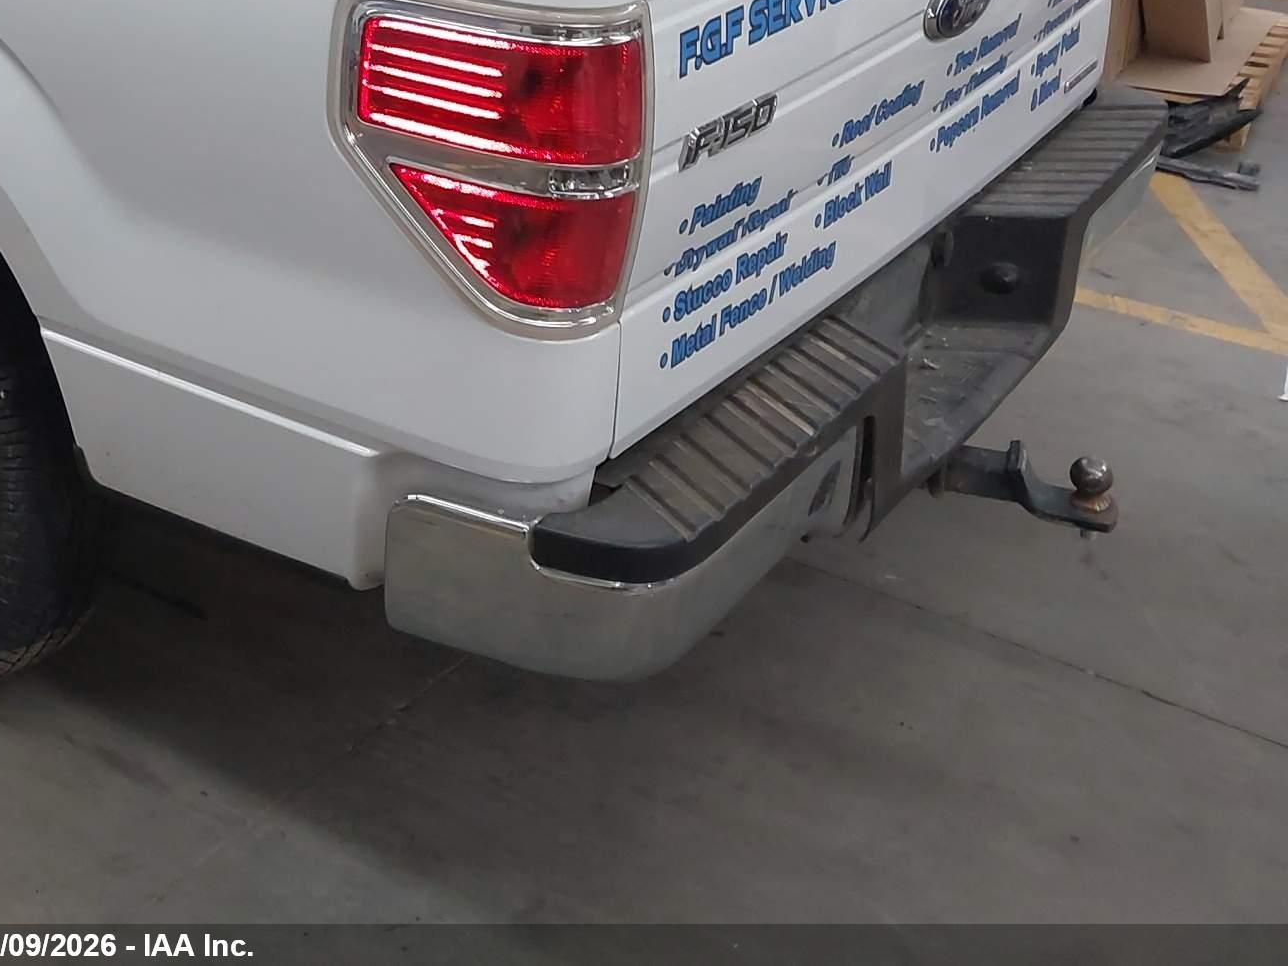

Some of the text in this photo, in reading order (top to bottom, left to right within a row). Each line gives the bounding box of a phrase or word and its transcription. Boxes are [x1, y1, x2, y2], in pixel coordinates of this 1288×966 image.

[688, 175, 763, 236] Painting
[823, 181, 865, 230] Block
[670, 313, 717, 369] Metal
[718, 286, 768, 337] Fence
[778, 240, 838, 297] Welding
[673, 232, 789, 322] Stucco Repair
